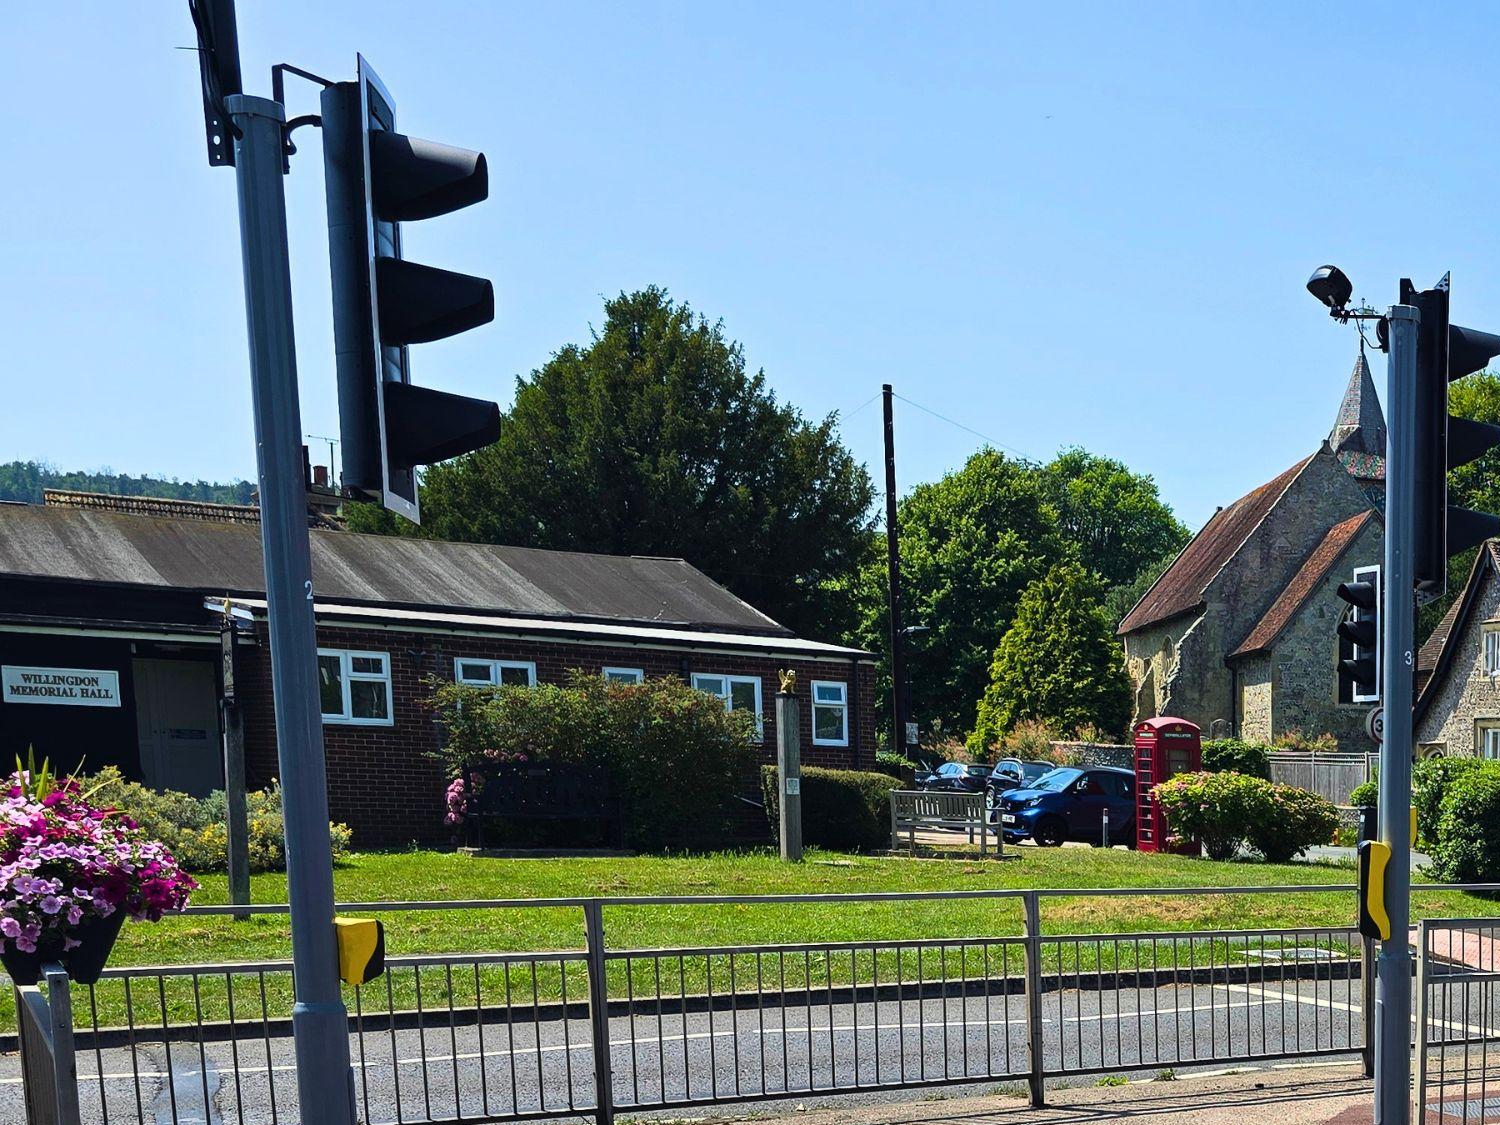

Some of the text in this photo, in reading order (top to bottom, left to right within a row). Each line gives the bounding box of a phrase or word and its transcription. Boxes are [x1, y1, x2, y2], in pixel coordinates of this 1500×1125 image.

[304, 580, 314, 600] 2
[1404, 650, 1413, 666] 3
[20, 673, 99, 687] WILLINGDON
[9, 685, 114, 699] MEMORIAL HALL
